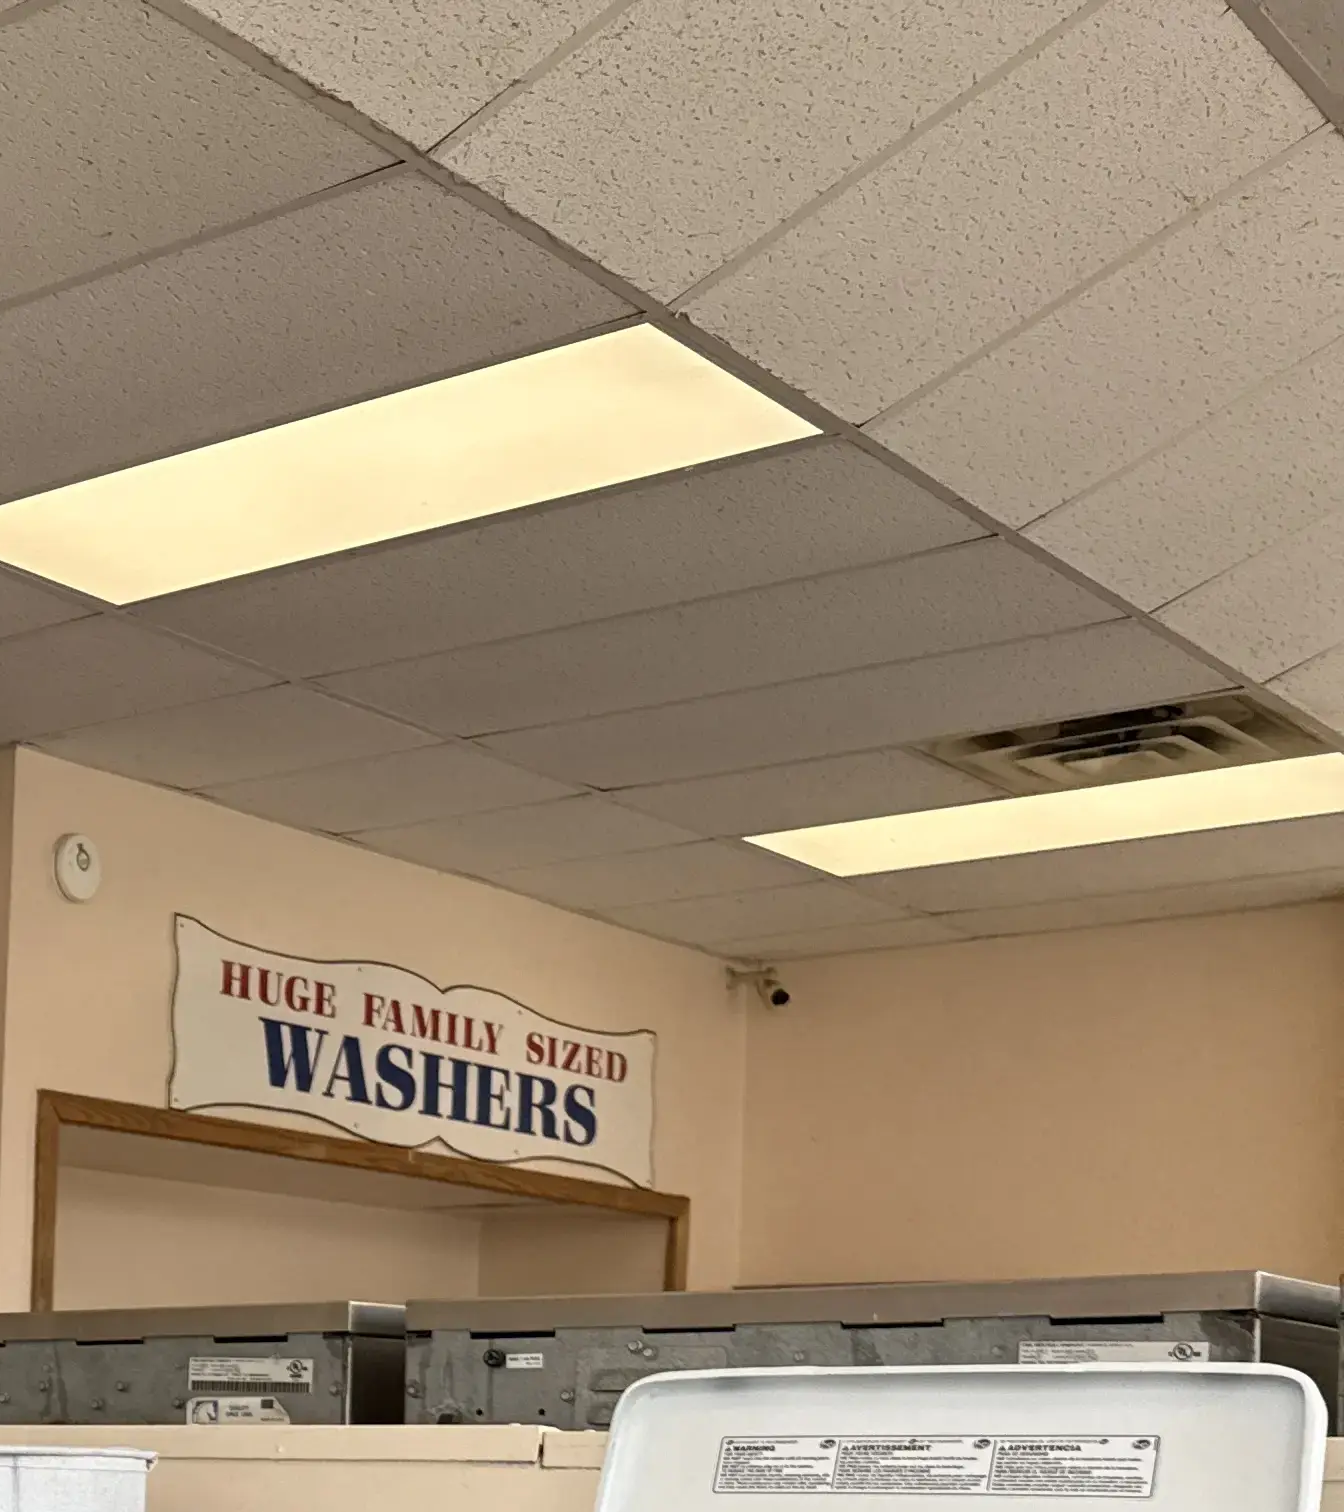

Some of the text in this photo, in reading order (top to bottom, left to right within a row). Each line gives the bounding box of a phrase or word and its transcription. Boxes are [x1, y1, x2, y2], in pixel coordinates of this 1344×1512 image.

[219, 960, 628, 1083] HUGE FAMILY SIZED
[259, 1017, 598, 1147] WASHERS
[850, 1444, 932, 1452] AVERTISSEMENT
[1007, 1444, 1081, 1452] ADVERTENCIA
